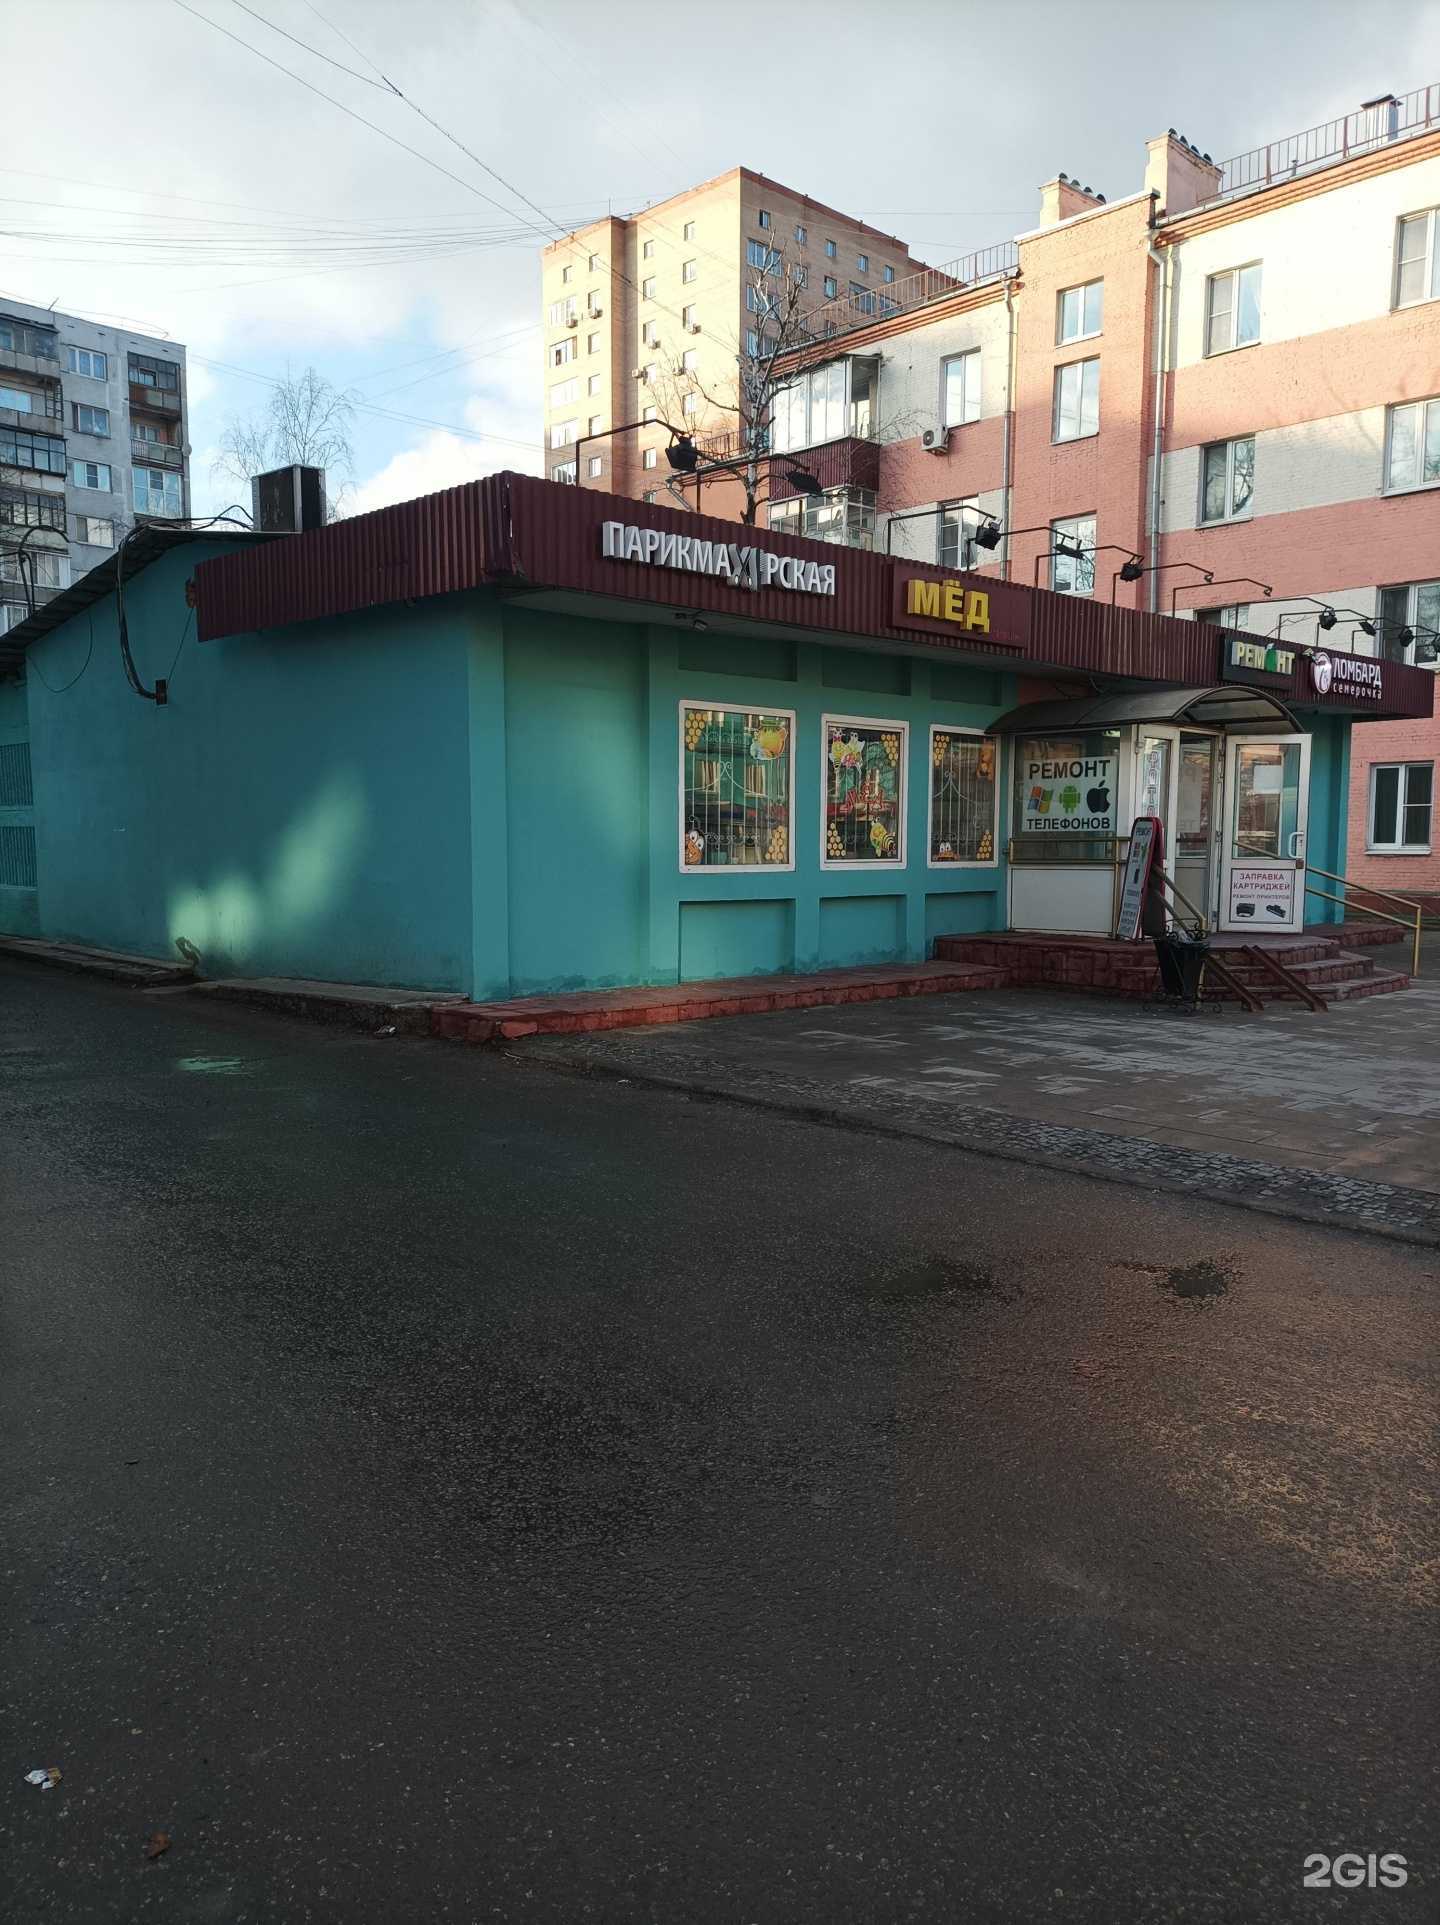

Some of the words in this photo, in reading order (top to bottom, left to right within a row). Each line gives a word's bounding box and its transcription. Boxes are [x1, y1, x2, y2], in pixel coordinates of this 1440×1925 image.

[908, 578, 990, 633] МЁД
[1332, 657, 1382, 689] ЛОМБАРД
[1028, 759, 1111, 780] РЕМОНТ
[1026, 817, 1111, 830] ТЕЛЕФОНОВ
[1239, 873, 1285, 881] ЗАПРАВКА
[1233, 882, 1290, 891] КАРТРИДЖЕЙ
